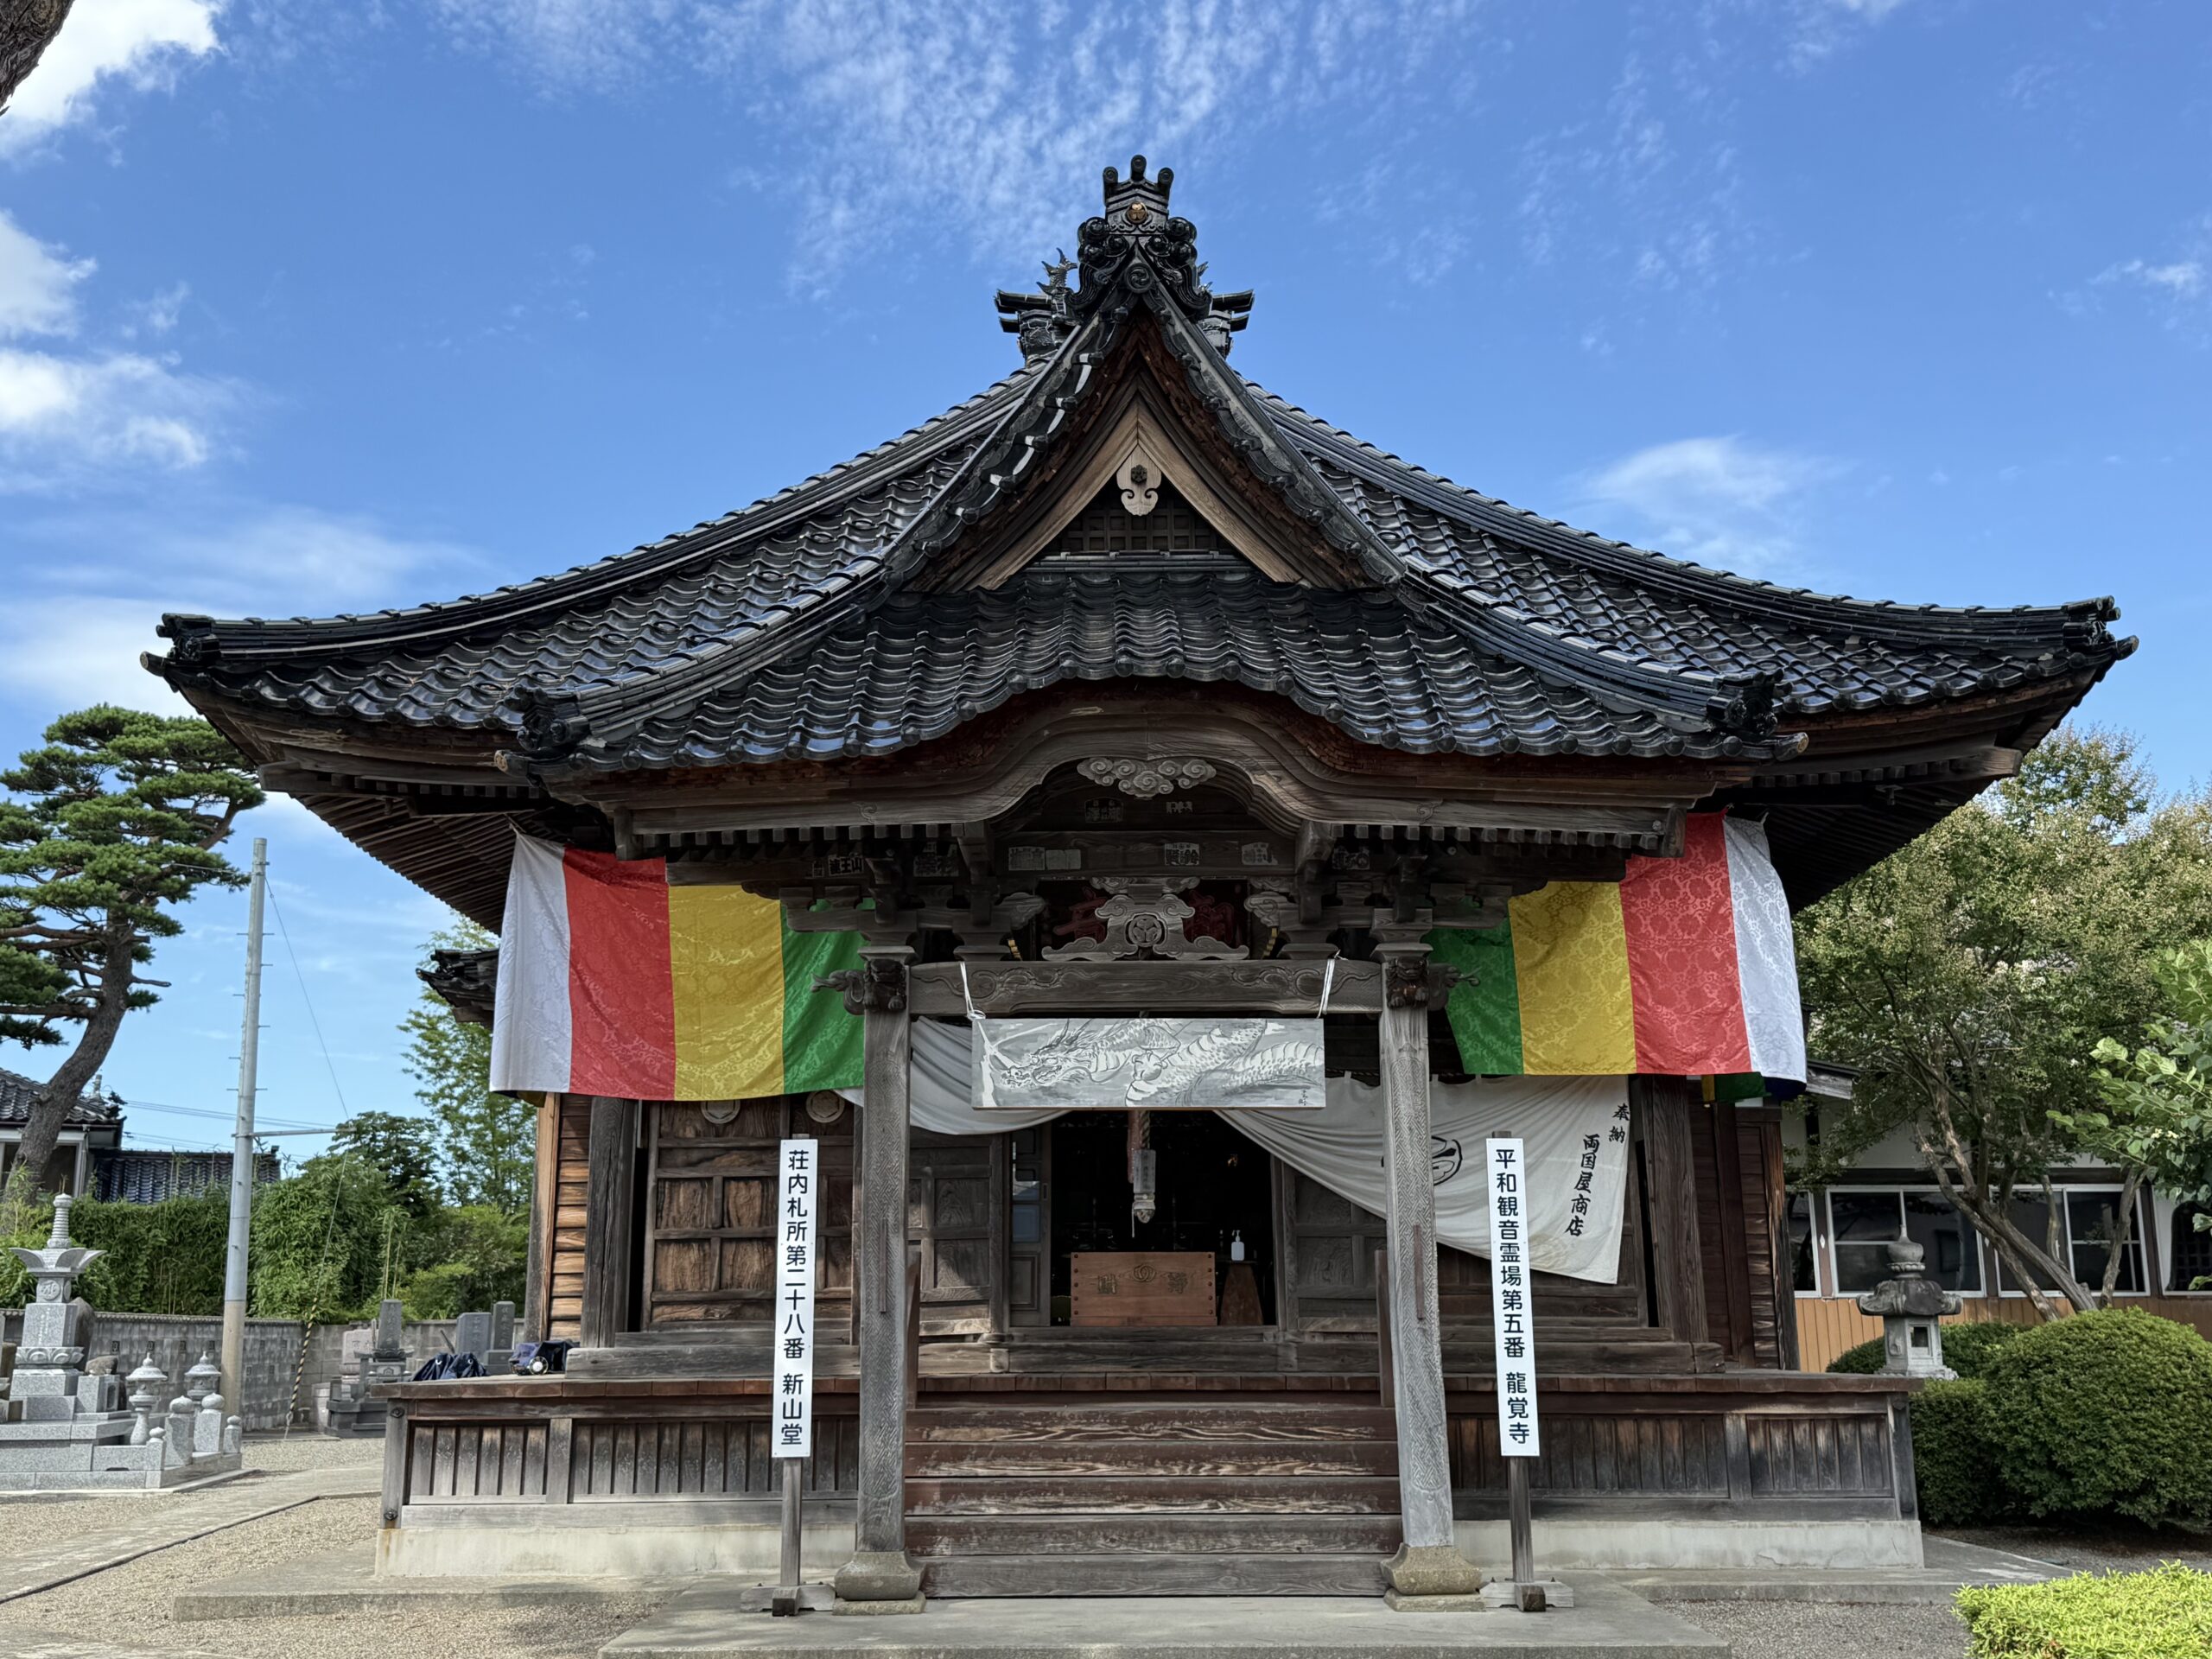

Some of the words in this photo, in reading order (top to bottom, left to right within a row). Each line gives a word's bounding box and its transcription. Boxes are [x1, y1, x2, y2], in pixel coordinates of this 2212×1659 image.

[1609, 1103, 1630, 1144] 奉納
[1564, 1133, 1600, 1237] 両国屋商店
[784, 1149, 809, 1359] 荘内札所第二十八番
[1495, 1148, 1525, 1358] 平和観音霊場第五番
[781, 1373, 804, 1446] 新山堂
[1505, 1371, 1530, 1445] 龍覚寺
